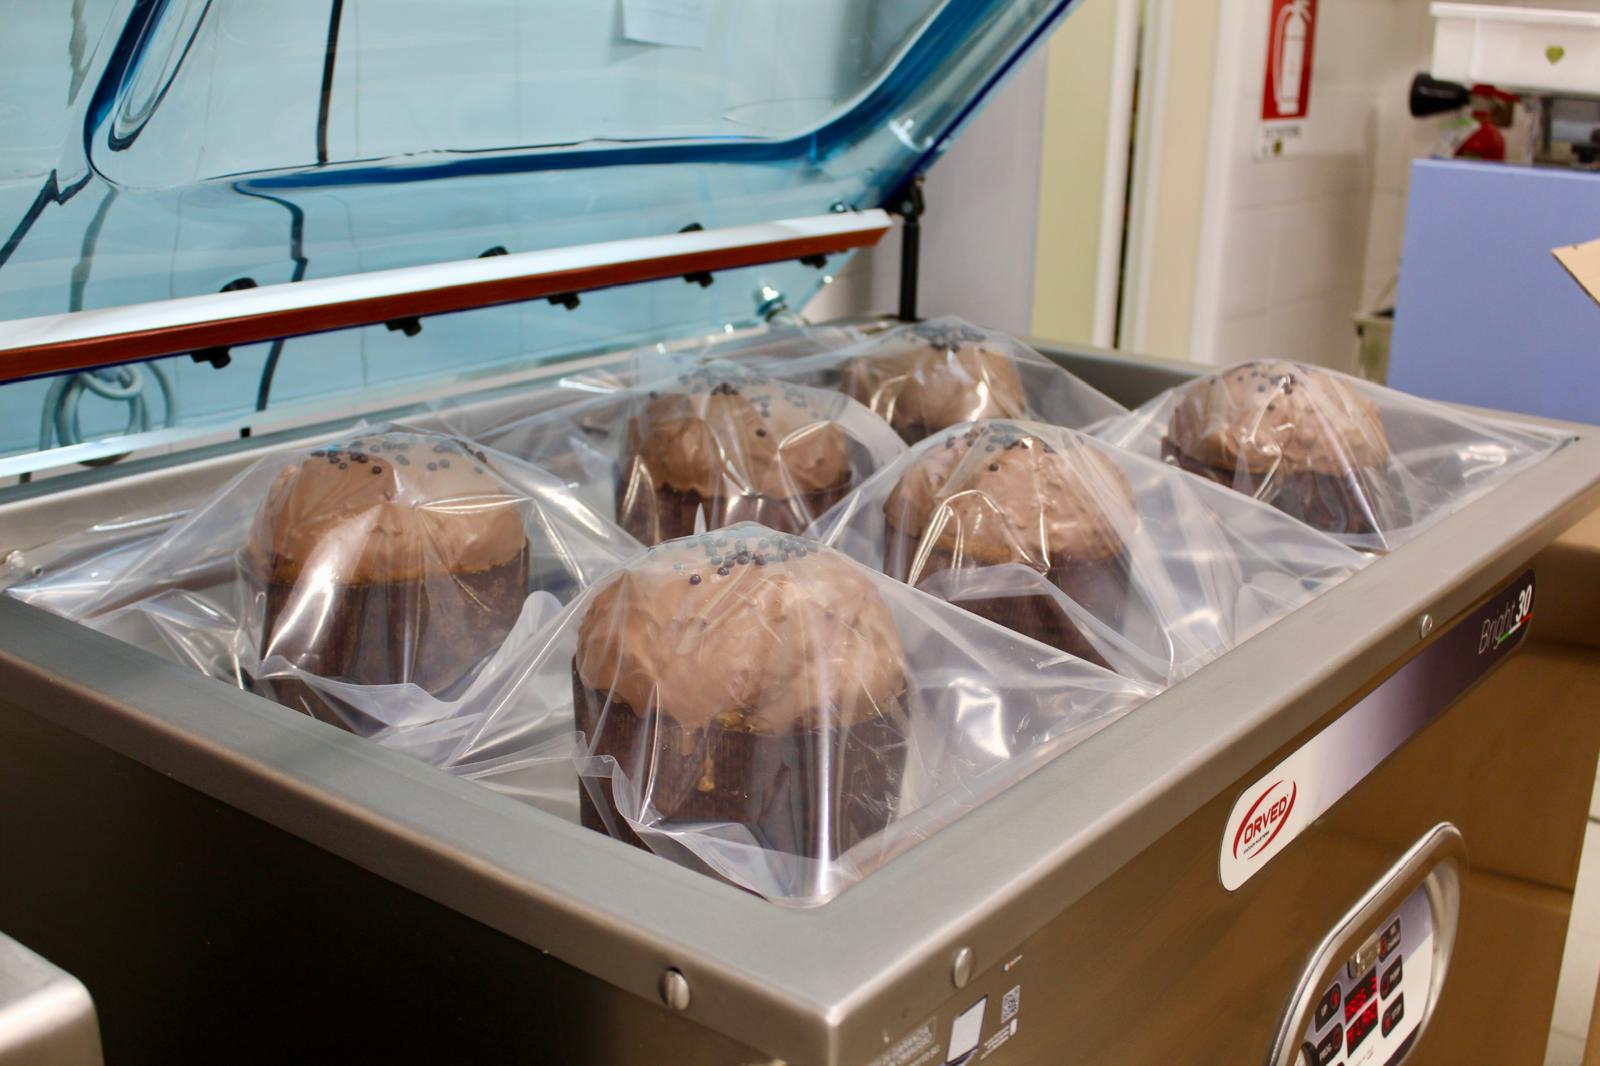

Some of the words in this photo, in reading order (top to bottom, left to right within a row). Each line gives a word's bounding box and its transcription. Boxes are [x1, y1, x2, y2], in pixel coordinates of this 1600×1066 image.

[1478, 600, 1515, 655] Bright
[1515, 584, 1533, 623] 30
[1243, 796, 1287, 845] ORVED
